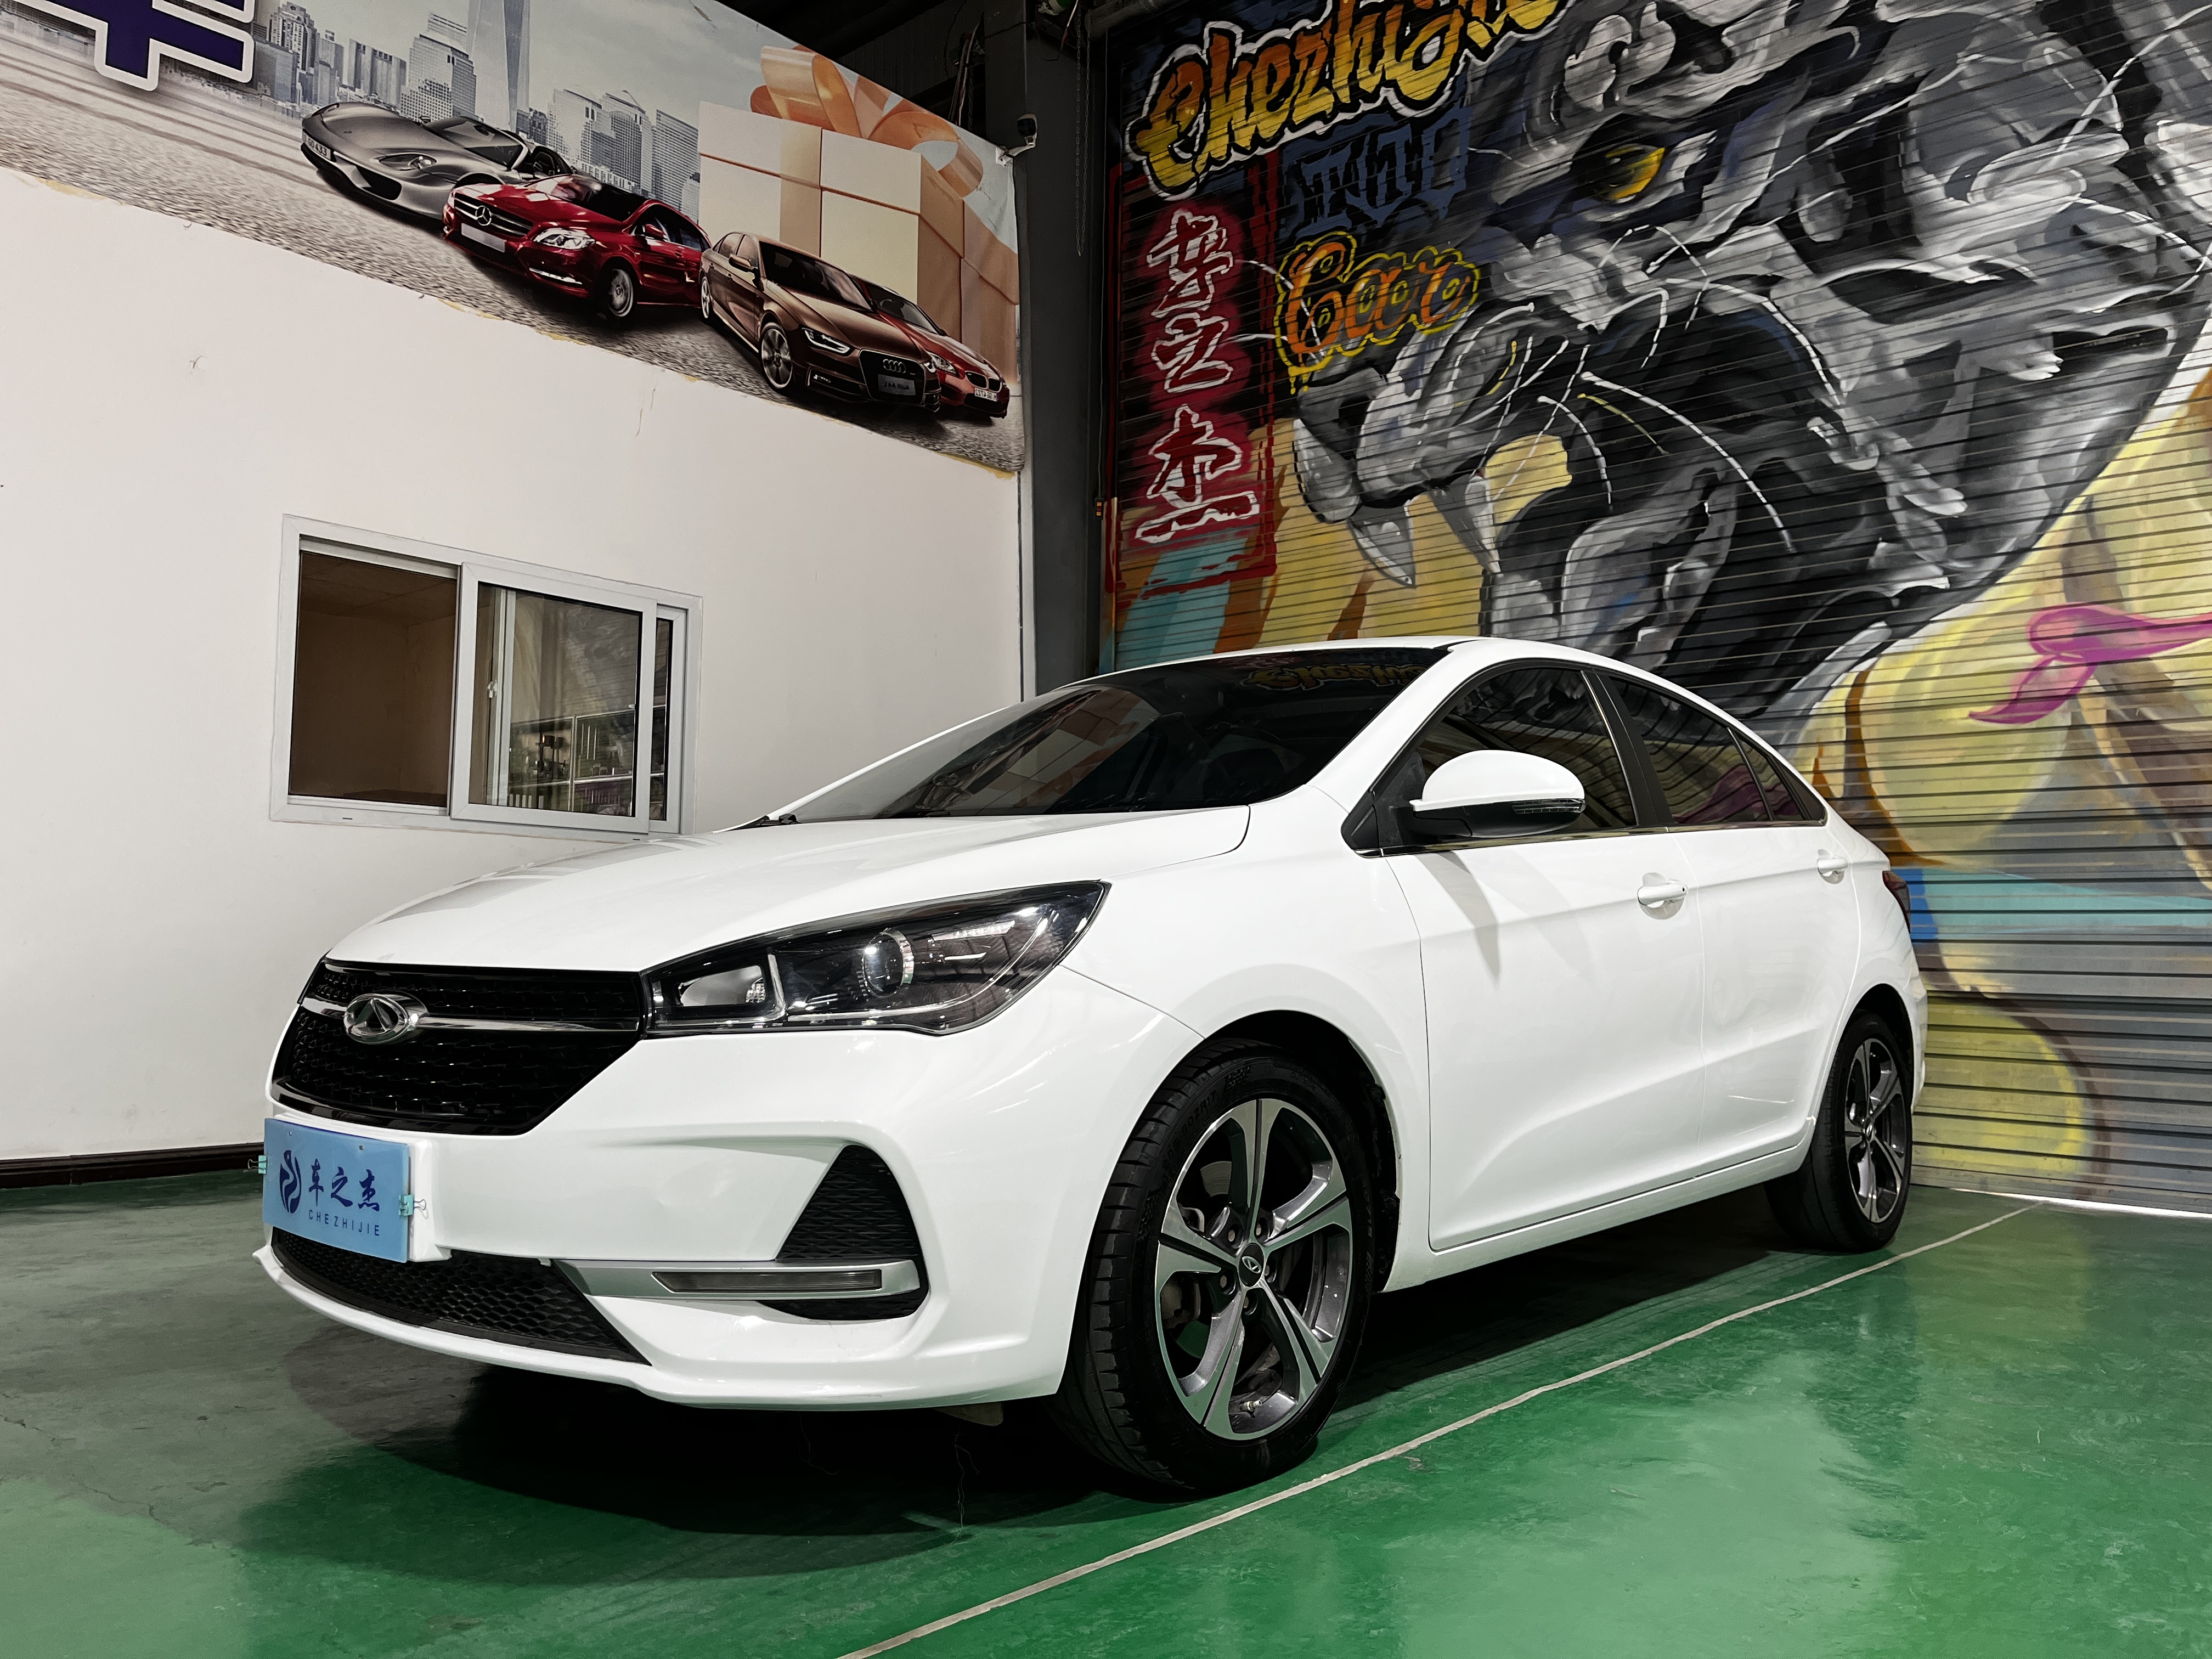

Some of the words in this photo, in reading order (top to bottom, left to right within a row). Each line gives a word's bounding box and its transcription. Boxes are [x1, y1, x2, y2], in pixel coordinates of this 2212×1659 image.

[308, 1158, 380, 1212] 车之杰
[308, 1209, 380, 1237] CHEZHIJIE
